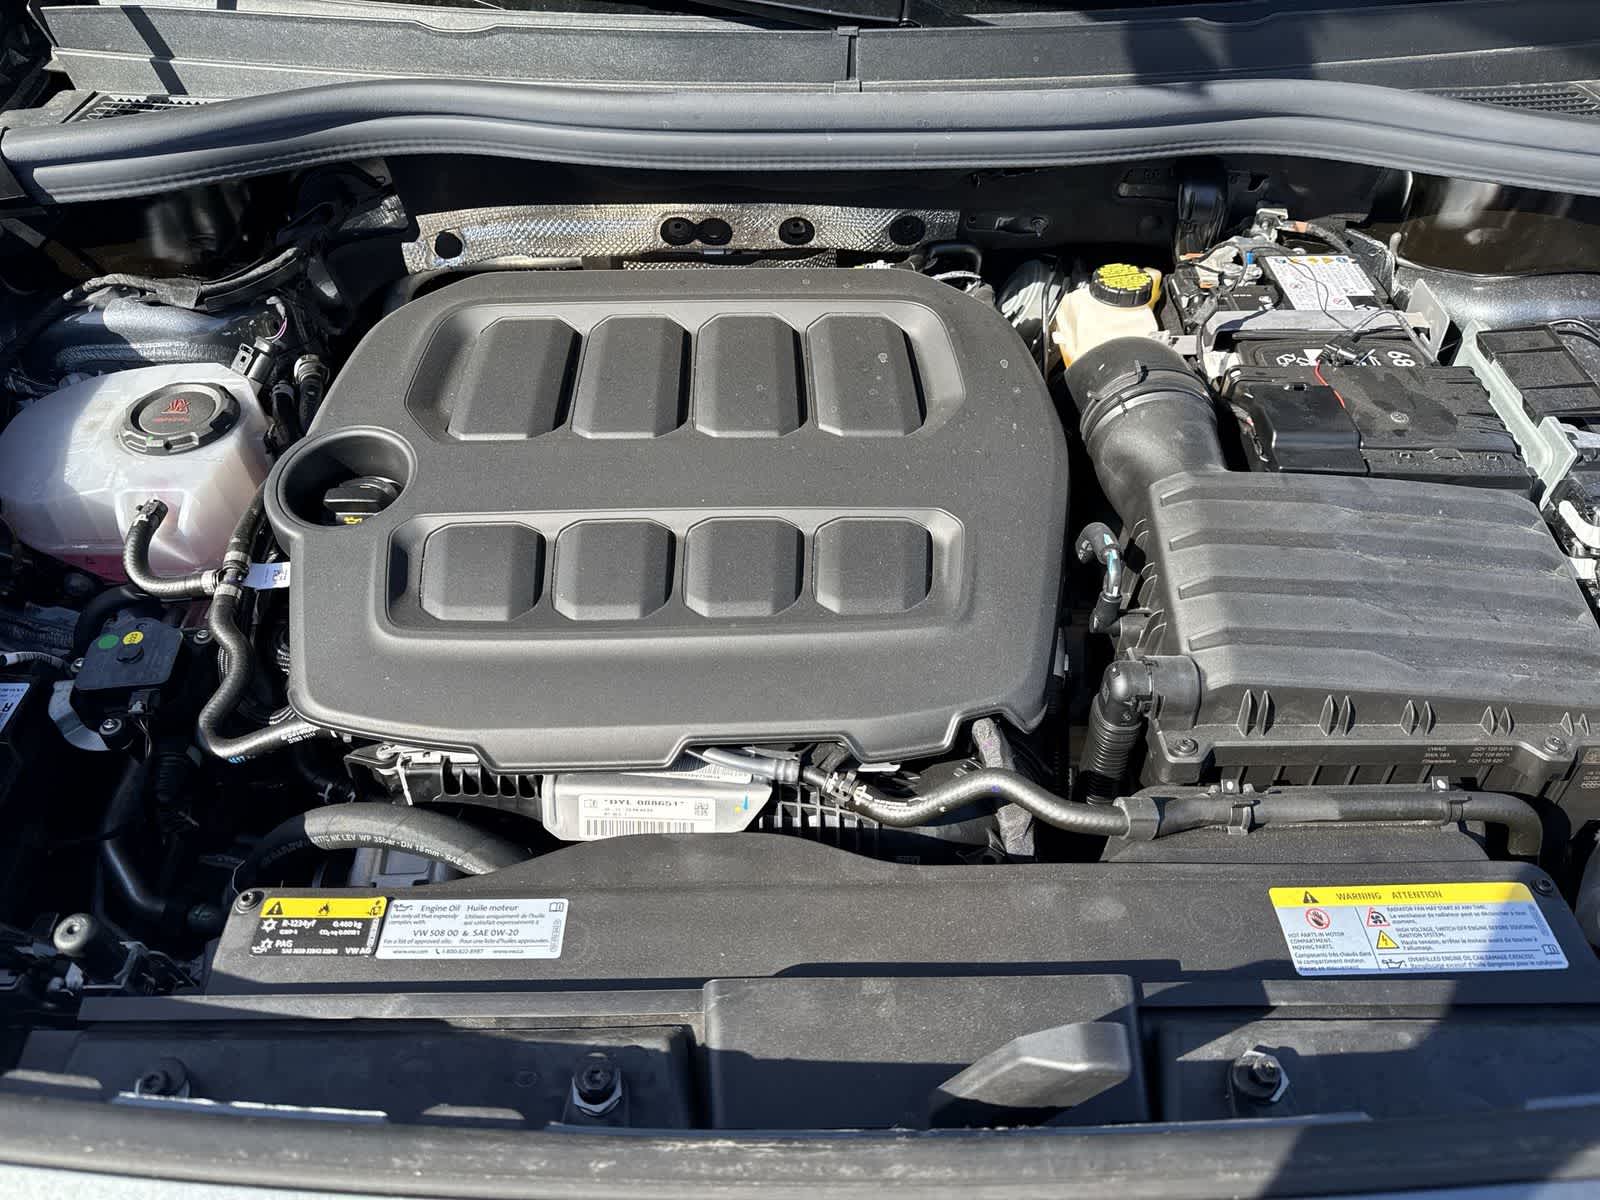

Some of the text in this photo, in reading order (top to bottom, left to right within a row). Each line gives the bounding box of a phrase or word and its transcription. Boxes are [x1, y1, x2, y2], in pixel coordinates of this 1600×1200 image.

[1335, 891, 1382, 901] WARNING
[1391, 890, 1443, 899] ATTENTION
[421, 904, 460, 913] Engine Oil
[466, 904, 520, 912] Huile moteur
[353, 921, 363, 930] kg
[413, 929, 428, 937] VW
[429, 929, 445, 937] 508
[447, 929, 459, 937] 00
[472, 929, 489, 937] SAE
[491, 929, 519, 937] 0W-20
[275, 939, 294, 948] PAG
[345, 946, 359, 955] VW
